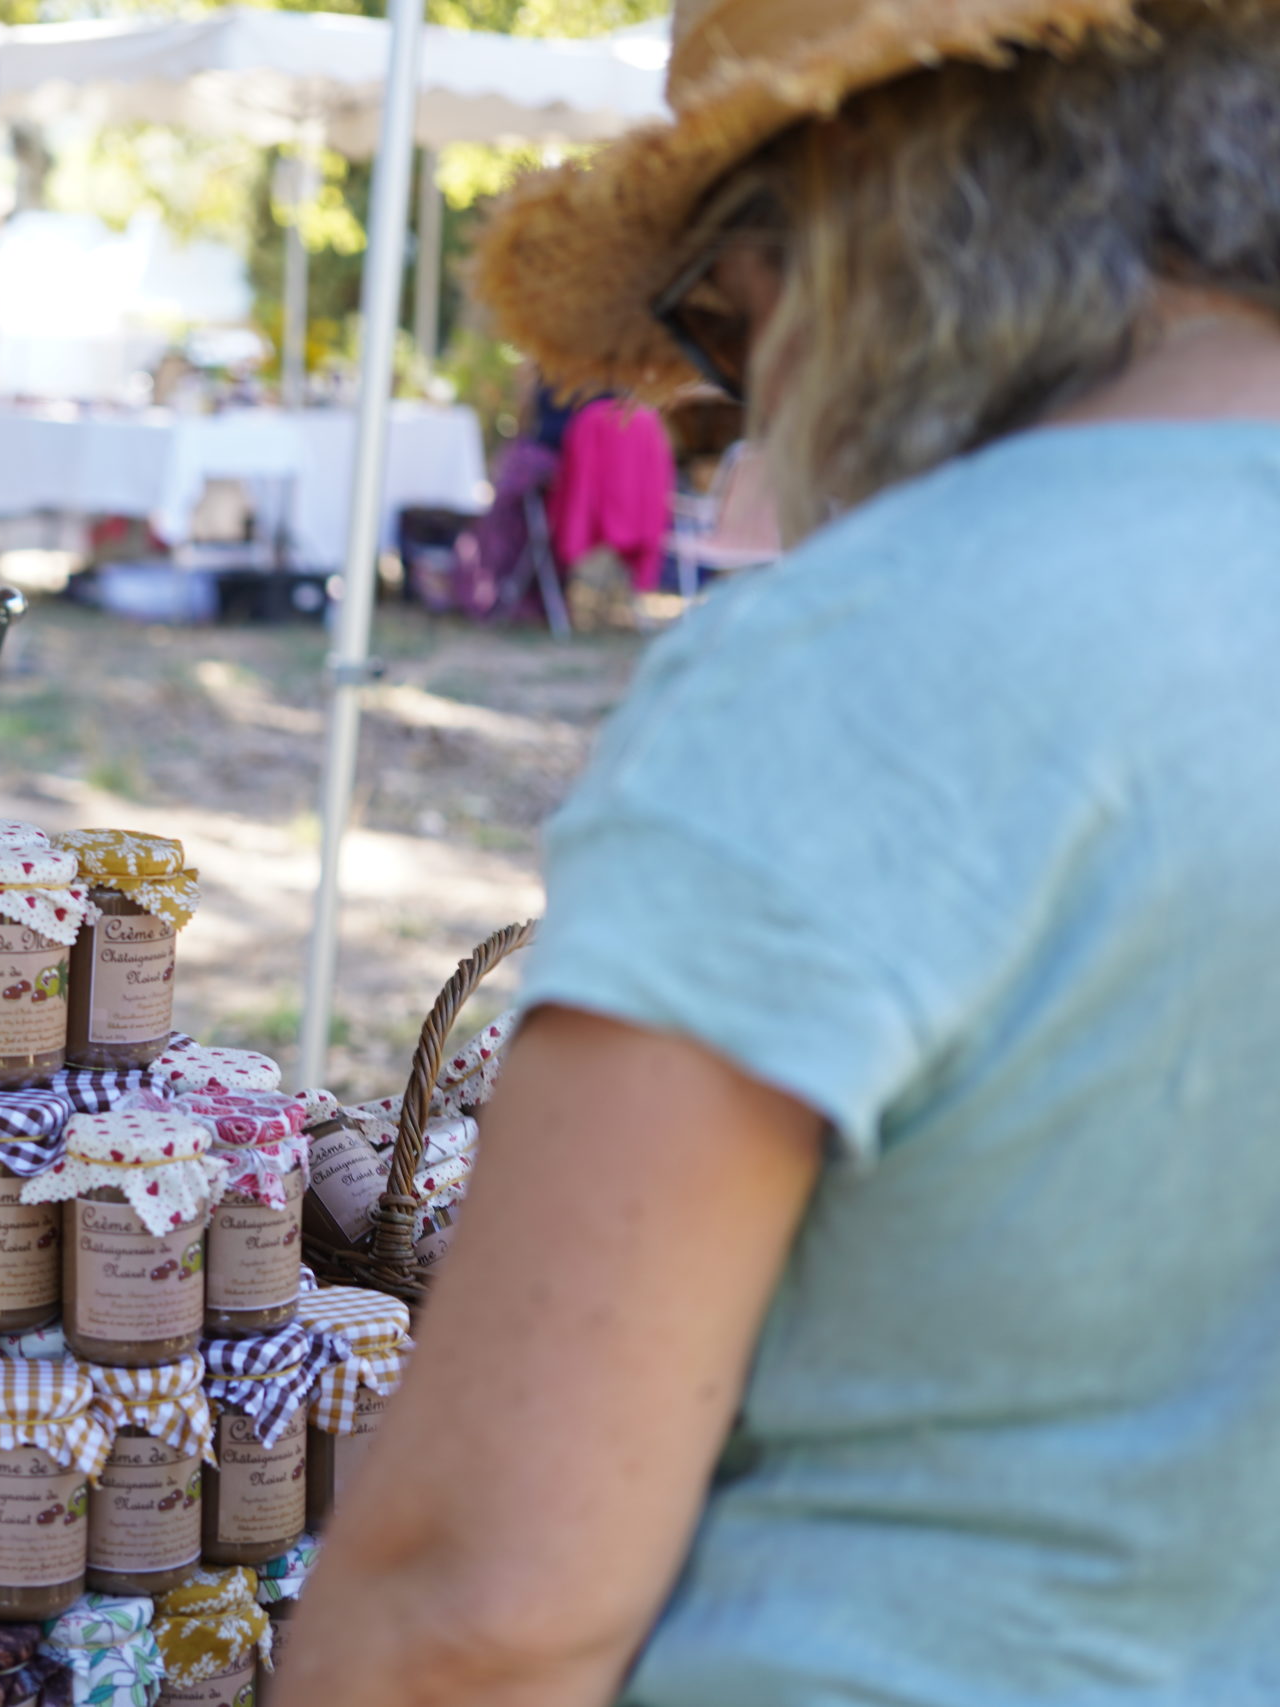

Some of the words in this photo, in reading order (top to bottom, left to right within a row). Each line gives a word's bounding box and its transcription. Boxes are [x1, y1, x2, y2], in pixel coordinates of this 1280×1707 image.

[105, 919, 155, 940] Crème
[81, 1206, 133, 1231] Crème
[150, 1447, 167, 1463] de
[30, 1458, 48, 1474] de
